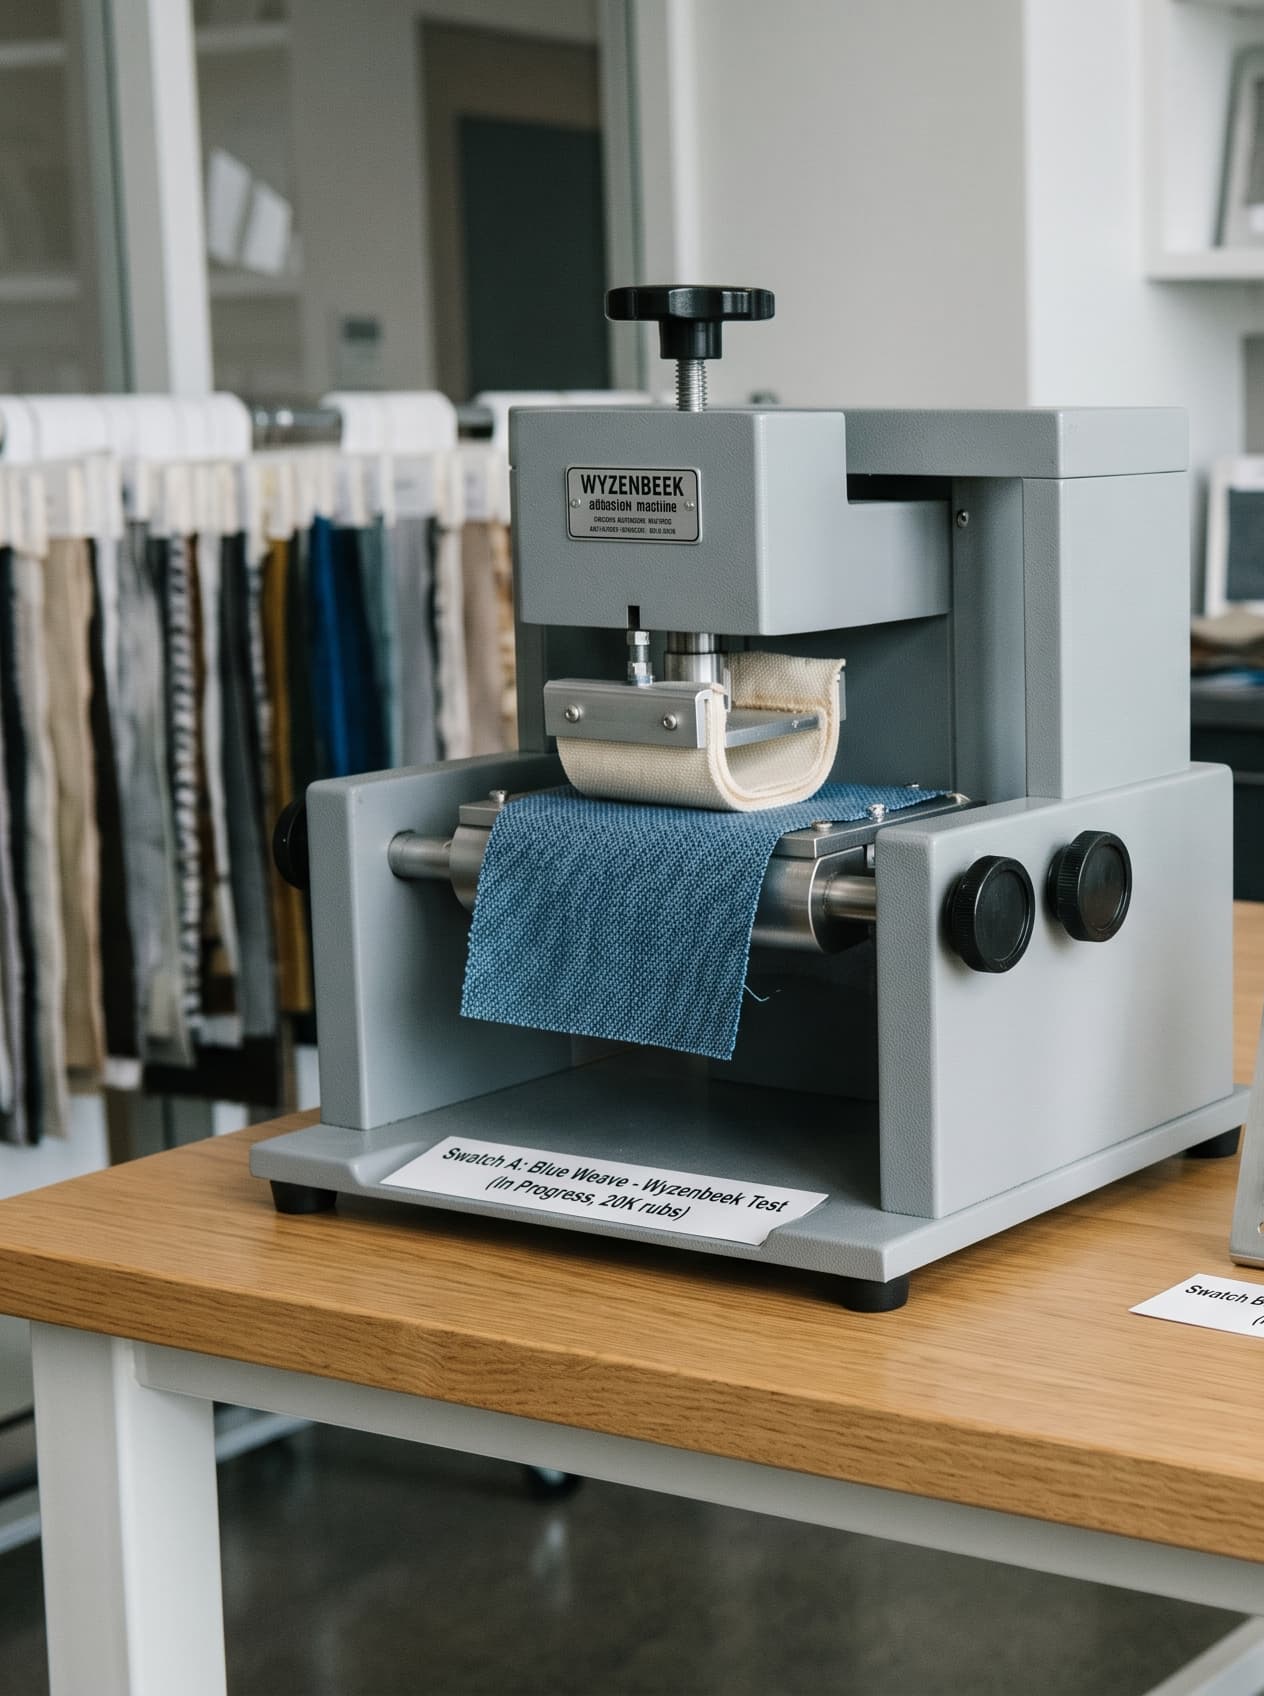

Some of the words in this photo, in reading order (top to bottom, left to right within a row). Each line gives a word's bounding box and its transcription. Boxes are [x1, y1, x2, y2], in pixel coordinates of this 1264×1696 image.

[580, 474, 684, 497] WYZENBEEK
[442, 1147, 505, 1168] Swatch
[503, 1158, 528, 1171] A:
[527, 1161, 570, 1178] Blue
[570, 1167, 629, 1187] Weave
[641, 1178, 745, 1206] Wyzenbeek
[747, 1195, 789, 1212] Test
[485, 1176, 515, 1190] (In
[513, 1180, 595, 1206] Progress,
[598, 1194, 643, 1210] 20K
[638, 1203, 691, 1221] rubs)
[1185, 1285, 1249, 1303] Swatch
